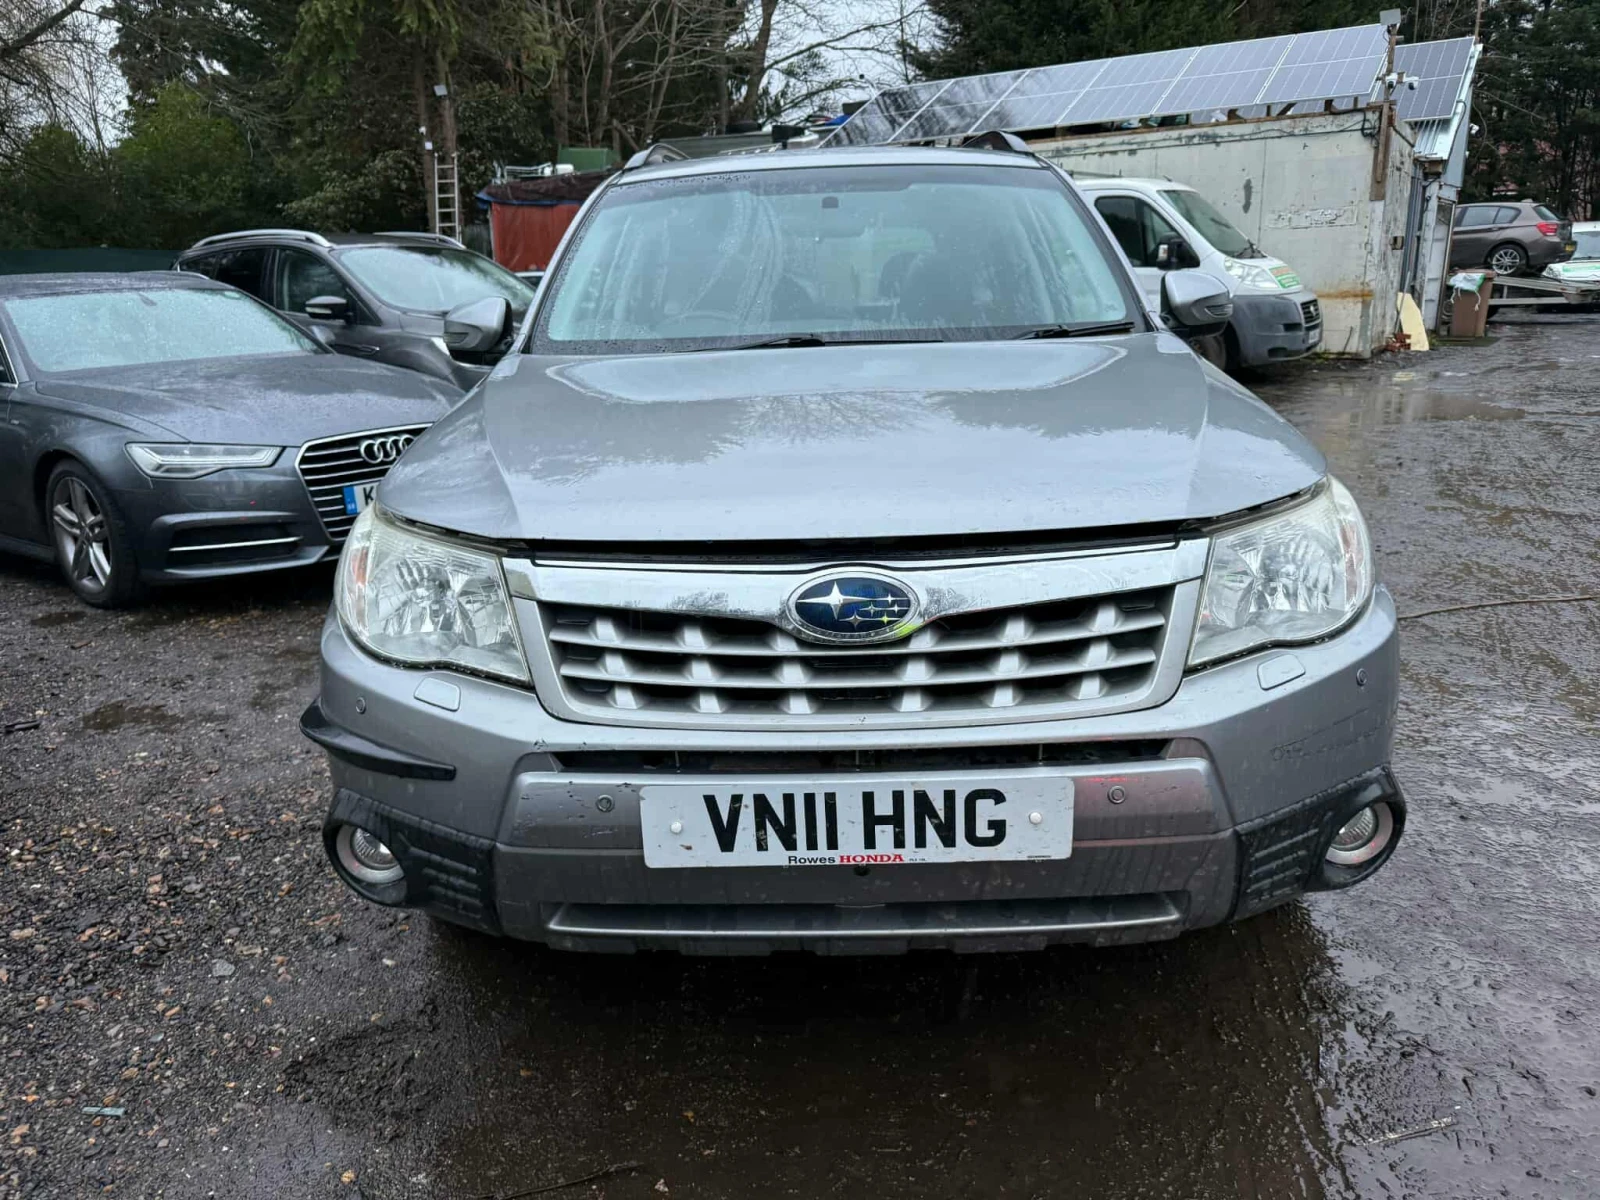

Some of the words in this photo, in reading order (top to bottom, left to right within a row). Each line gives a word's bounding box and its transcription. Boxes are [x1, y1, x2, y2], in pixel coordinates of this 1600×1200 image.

[862, 788, 1007, 850] HNG
[788, 855, 836, 864] Rowes
[840, 854, 904, 863] HONDA
